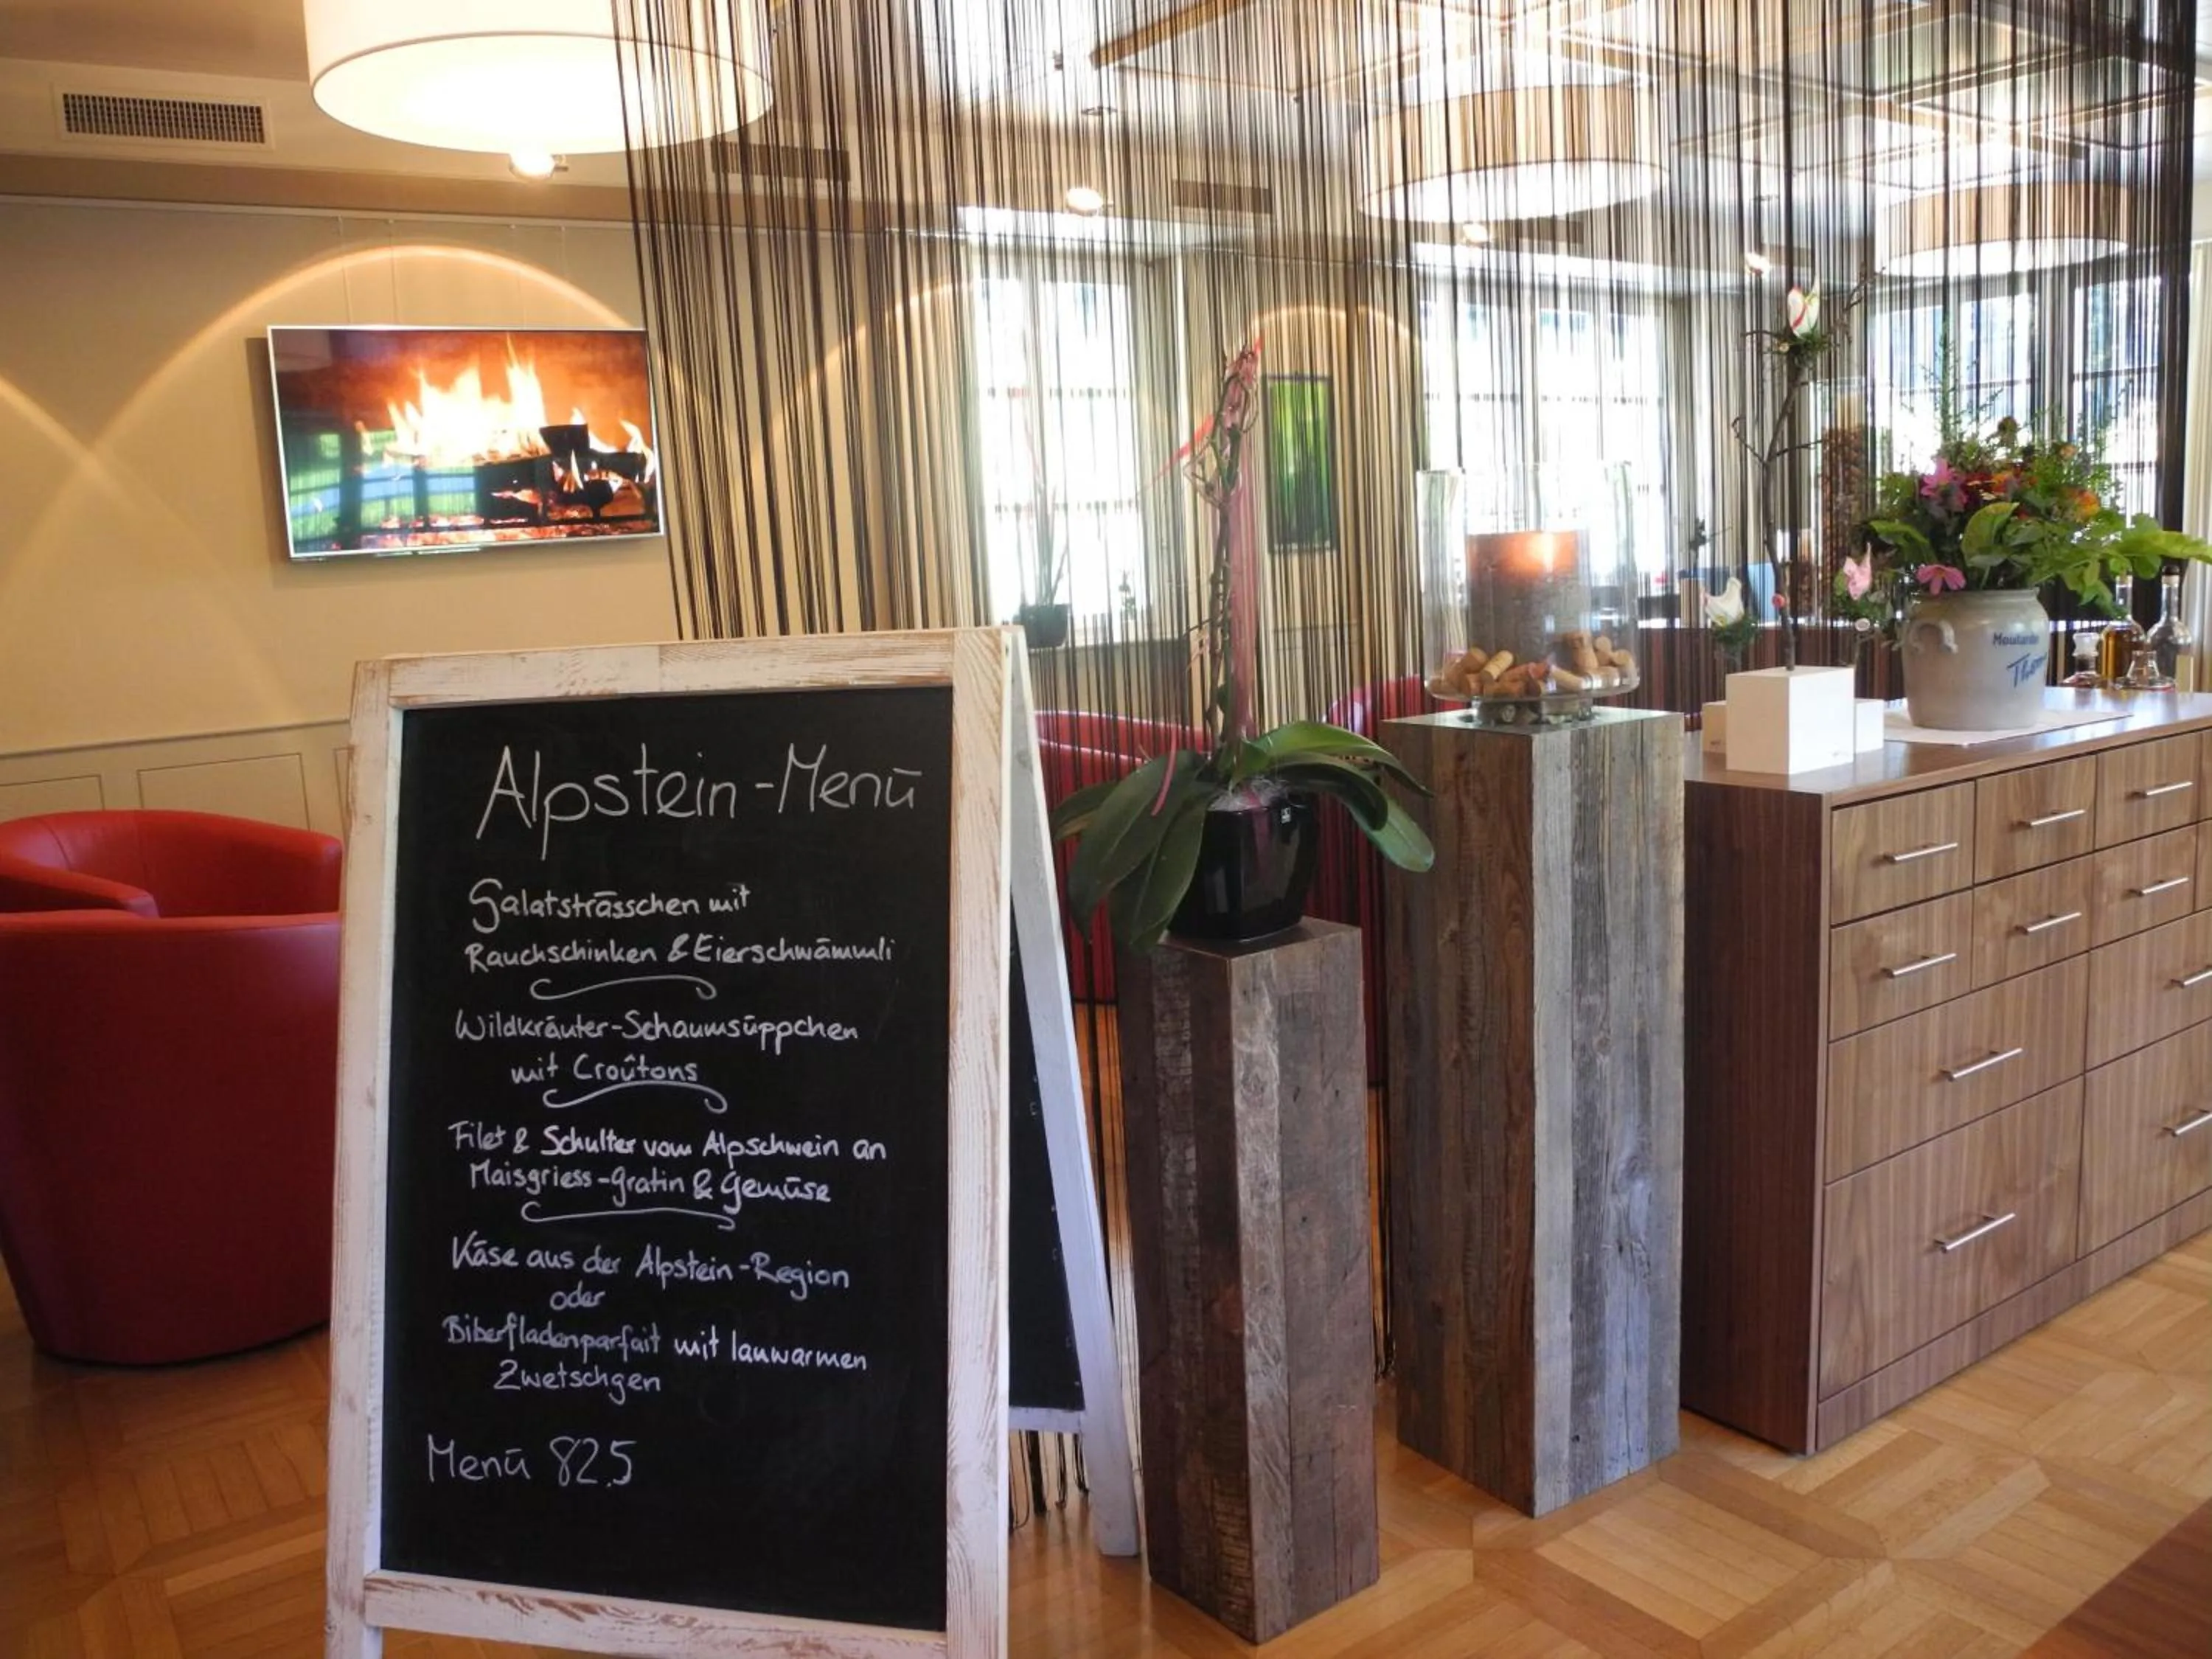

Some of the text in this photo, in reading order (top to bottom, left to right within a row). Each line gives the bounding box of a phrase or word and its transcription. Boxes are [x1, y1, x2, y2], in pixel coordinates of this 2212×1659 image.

[476, 742, 922, 860] Alpstein-Menü
[709, 884, 750, 912] mit
[465, 933, 894, 973] Rauchschinken & Eierschwämmli
[456, 1009, 858, 1057] Wildkräuter-Schaumsüppchen
[511, 1053, 698, 1084] mit Croûtons
[448, 1120, 887, 1172] Filet & Schulter vom Alpschwein an
[692, 1168, 713, 1200] &
[452, 1231, 849, 1300] Käse aus der Alpstein-Region
[550, 1284, 605, 1310] oder
[674, 1325, 720, 1360] mit
[731, 1329, 867, 1371] lauwarmen
[493, 1357, 661, 1405] Zwetschgen
[428, 1434, 530, 1481] Menü
